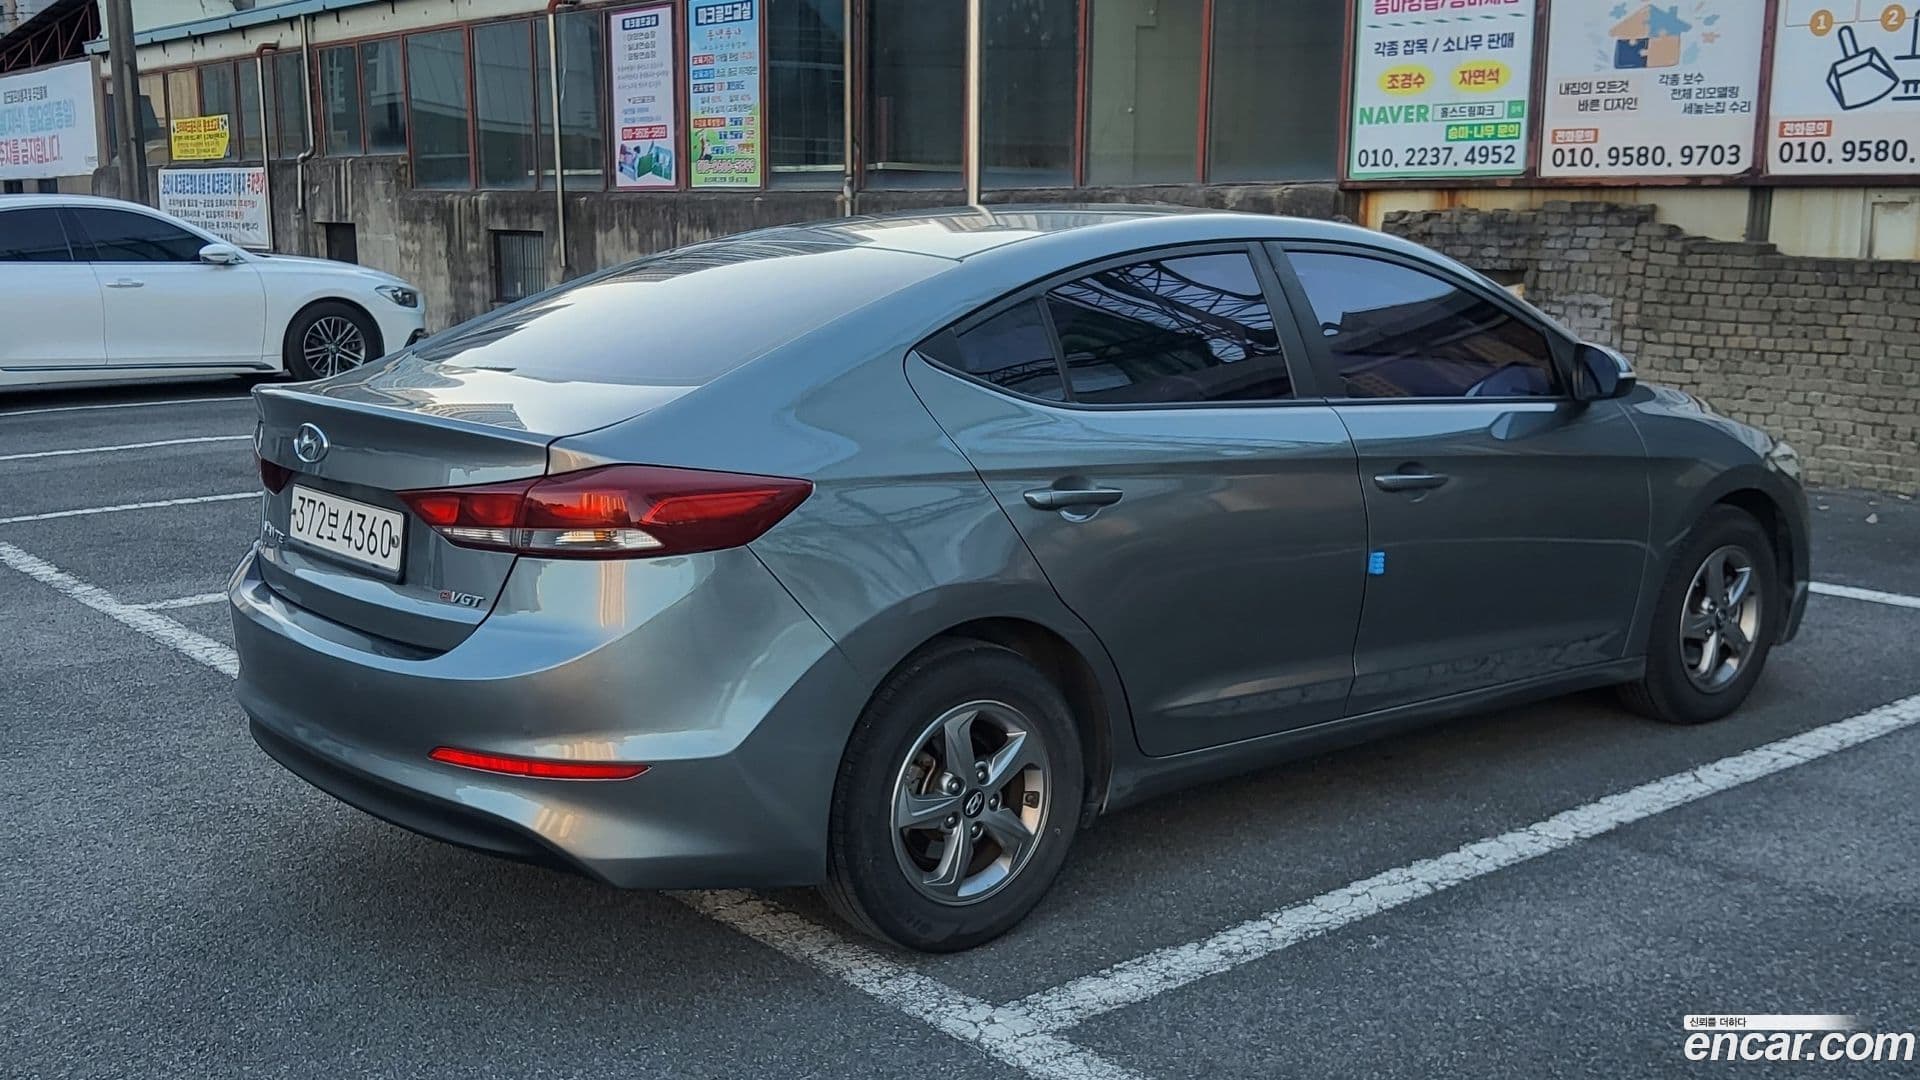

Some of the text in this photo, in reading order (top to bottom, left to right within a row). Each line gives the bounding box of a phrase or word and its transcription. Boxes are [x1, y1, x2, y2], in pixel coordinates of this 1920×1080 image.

[697, 2, 751, 24] 파크골프교실
[1888, 9, 1898, 25] 2
[1816, 15, 1826, 30] 1
[1374, 41, 1399, 57] 각종
[1403, 38, 1428, 55] 잡목
[1443, 34, 1483, 52] 소나무
[1487, 32, 1515, 49] 판매
[1387, 68, 1500, 89] 조경수 자연석
[1659, 72, 1704, 86] 각종 보수
[1559, 80, 1629, 95] 내집의 모든것
[1671, 86, 1740, 100] 전체 리모델링
[1578, 97, 1639, 112] 바른 디자인
[1728, 100, 1751, 113] 수리
[1359, 104, 1430, 125] NAVER
[1497, 123, 1519, 138] 문의
[295, 496, 393, 559] 372보4360
